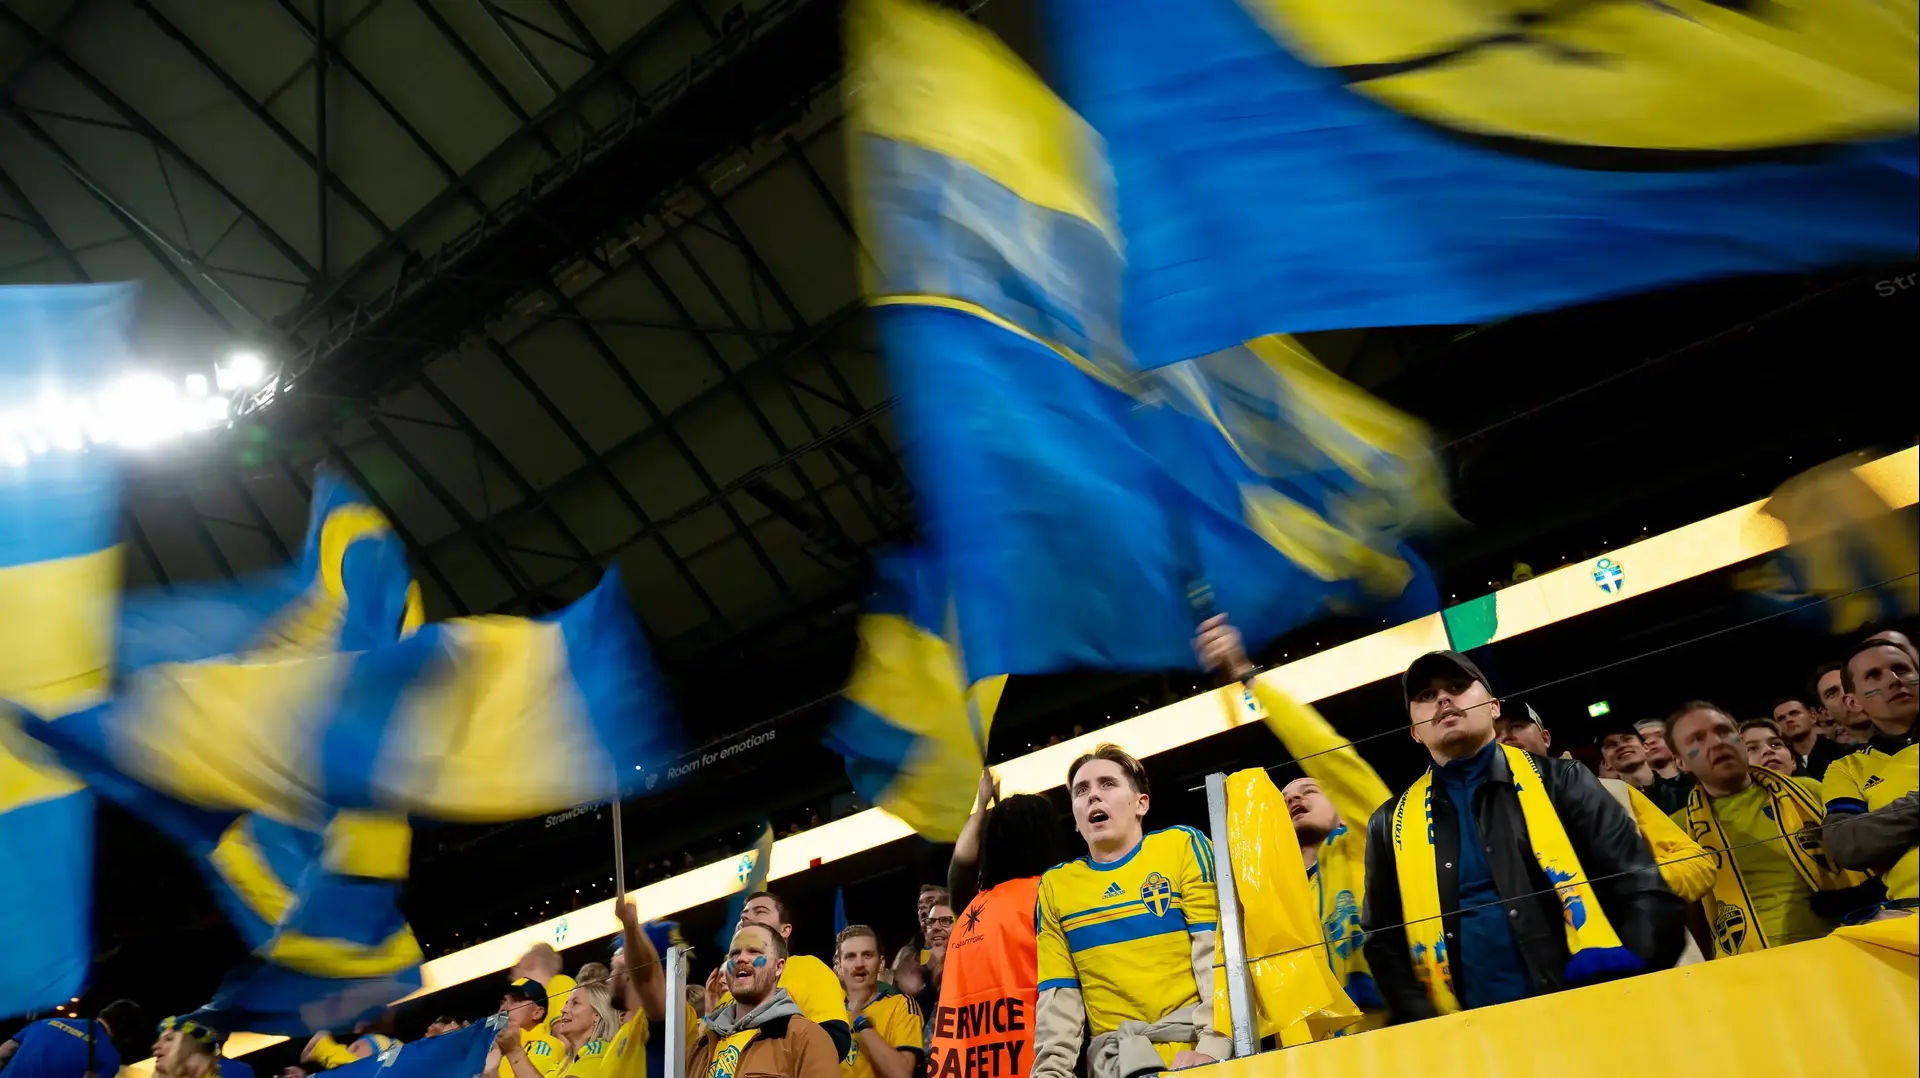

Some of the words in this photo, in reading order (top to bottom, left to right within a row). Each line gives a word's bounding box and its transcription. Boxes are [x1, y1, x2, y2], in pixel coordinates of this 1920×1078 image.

[667, 760, 699, 780] Room
[701, 752, 719, 767] for
[720, 729, 777, 760] emotions
[926, 1040, 1025, 1078] SAFETY
